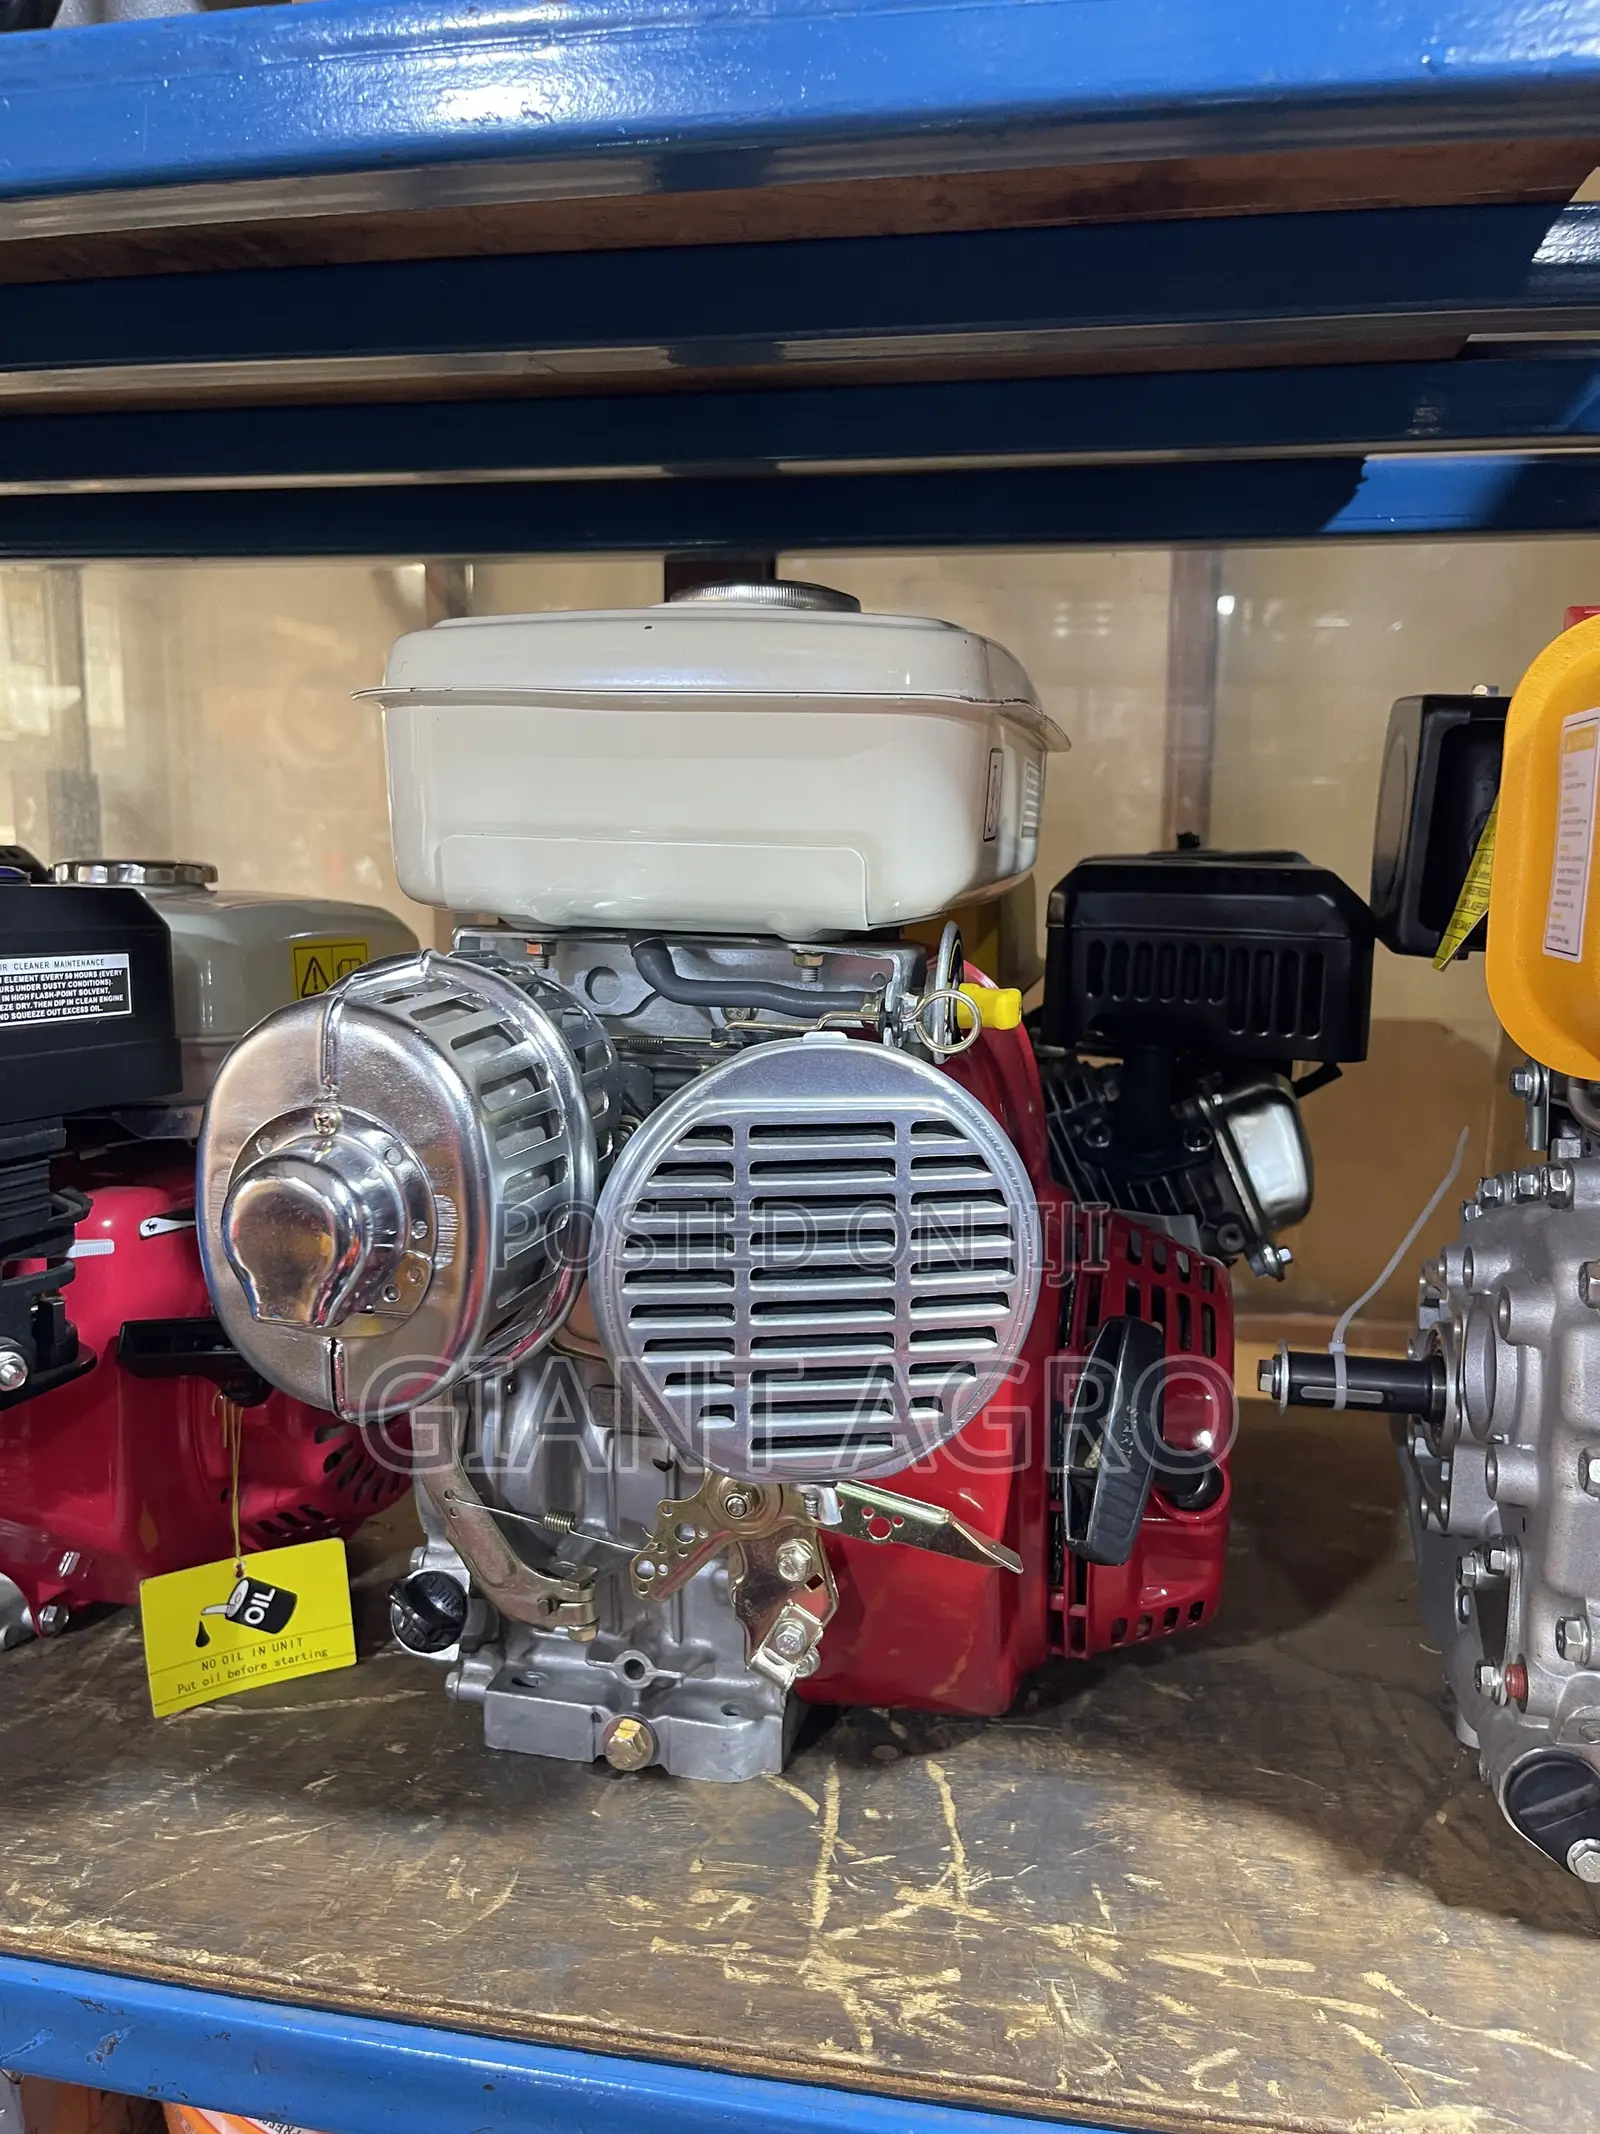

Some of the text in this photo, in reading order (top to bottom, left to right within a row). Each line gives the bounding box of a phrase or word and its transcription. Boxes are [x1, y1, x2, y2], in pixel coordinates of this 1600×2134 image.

[13, 961, 50, 971] CLEANER
[54, 958, 105, 969] MAINTENANCE
[4, 974, 39, 984] ELEMENT
[40, 973, 64, 981] EVERY
[74, 971, 97, 979] HOURS
[99, 969, 123, 978] (EVERY
[15, 983, 41, 992] UNDER
[43, 981, 66, 990] DUSTY
[68, 979, 113, 988] CONDITIONS).
[2, 994, 9, 1002] IN
[11, 993, 29, 1001] HIGH
[31, 989, 77, 1000] FLASH-POINT
[16, 1002, 32, 1010] DRY.
[34, 1000, 52, 1008] THEN
[54, 999, 65, 1007] DIP
[75, 997, 98, 1005] CLEAN
[99, 994, 123, 1003] ENGINE
[11, 1010, 45, 1020] SQUEEZE
[46, 1008, 61, 1016] OUT
[62, 1006, 89, 1015] EXCESS
[244, 1588, 276, 1625] OIL
[201, 1637, 304, 1671] NO OIL IN UNIT
[178, 1649, 329, 1694] Put oil before starting
